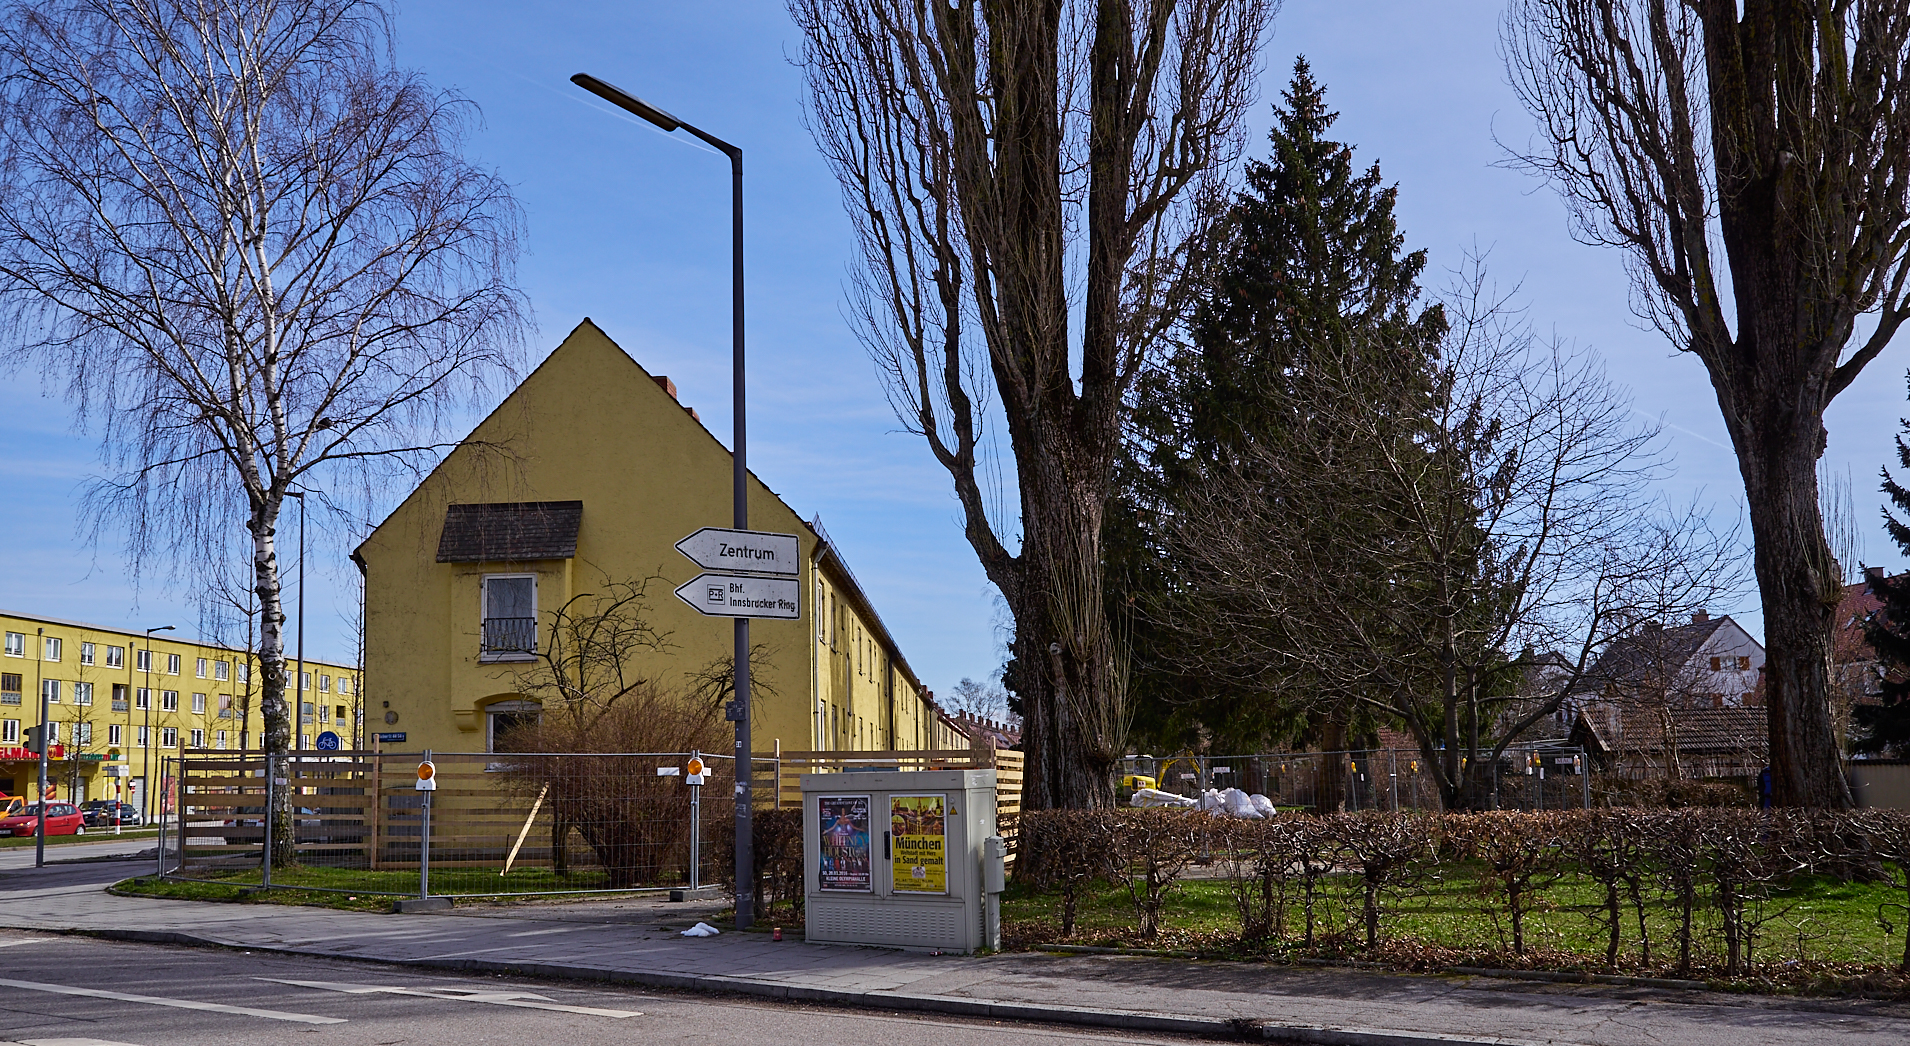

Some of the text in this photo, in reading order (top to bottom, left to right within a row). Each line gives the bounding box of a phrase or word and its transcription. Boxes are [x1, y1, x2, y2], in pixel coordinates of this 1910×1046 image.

[719, 543, 775, 560] Zentrum
[729, 582, 745, 594] Bhf.
[729, 597, 796, 612] Innsbrucker Ring
[823, 835, 867, 846] WHITNEY
[895, 836, 942, 850] München
[894, 855, 944, 867] in Sand gemalt
